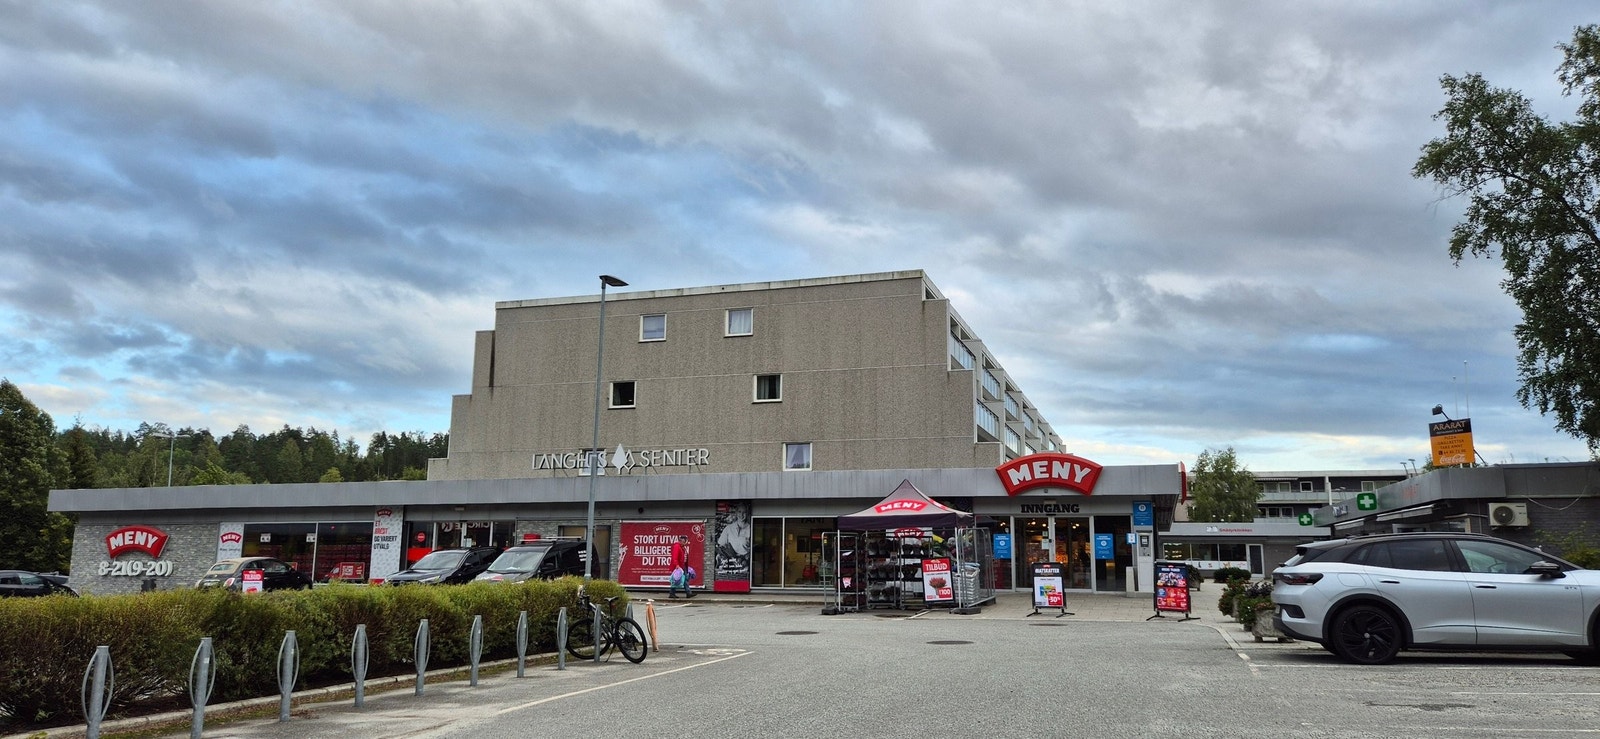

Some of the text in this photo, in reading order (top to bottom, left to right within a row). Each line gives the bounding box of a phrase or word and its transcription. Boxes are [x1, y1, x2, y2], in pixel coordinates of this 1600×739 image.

[1433, 421, 1466, 431] ARARAT
[532, 448, 710, 470] LANGHS SENTER
[1007, 460, 1091, 486] MENY
[881, 502, 922, 511] MENY
[1021, 504, 1080, 513] INNGANG
[109, 531, 158, 550] MENY
[634, 535, 658, 544] STORT
[634, 546, 671, 555] BILLIGERE
[642, 557, 671, 566] DU TRO
[98, 560, 173, 577] 8-21(9-20)
[925, 562, 948, 571] TILBUD
